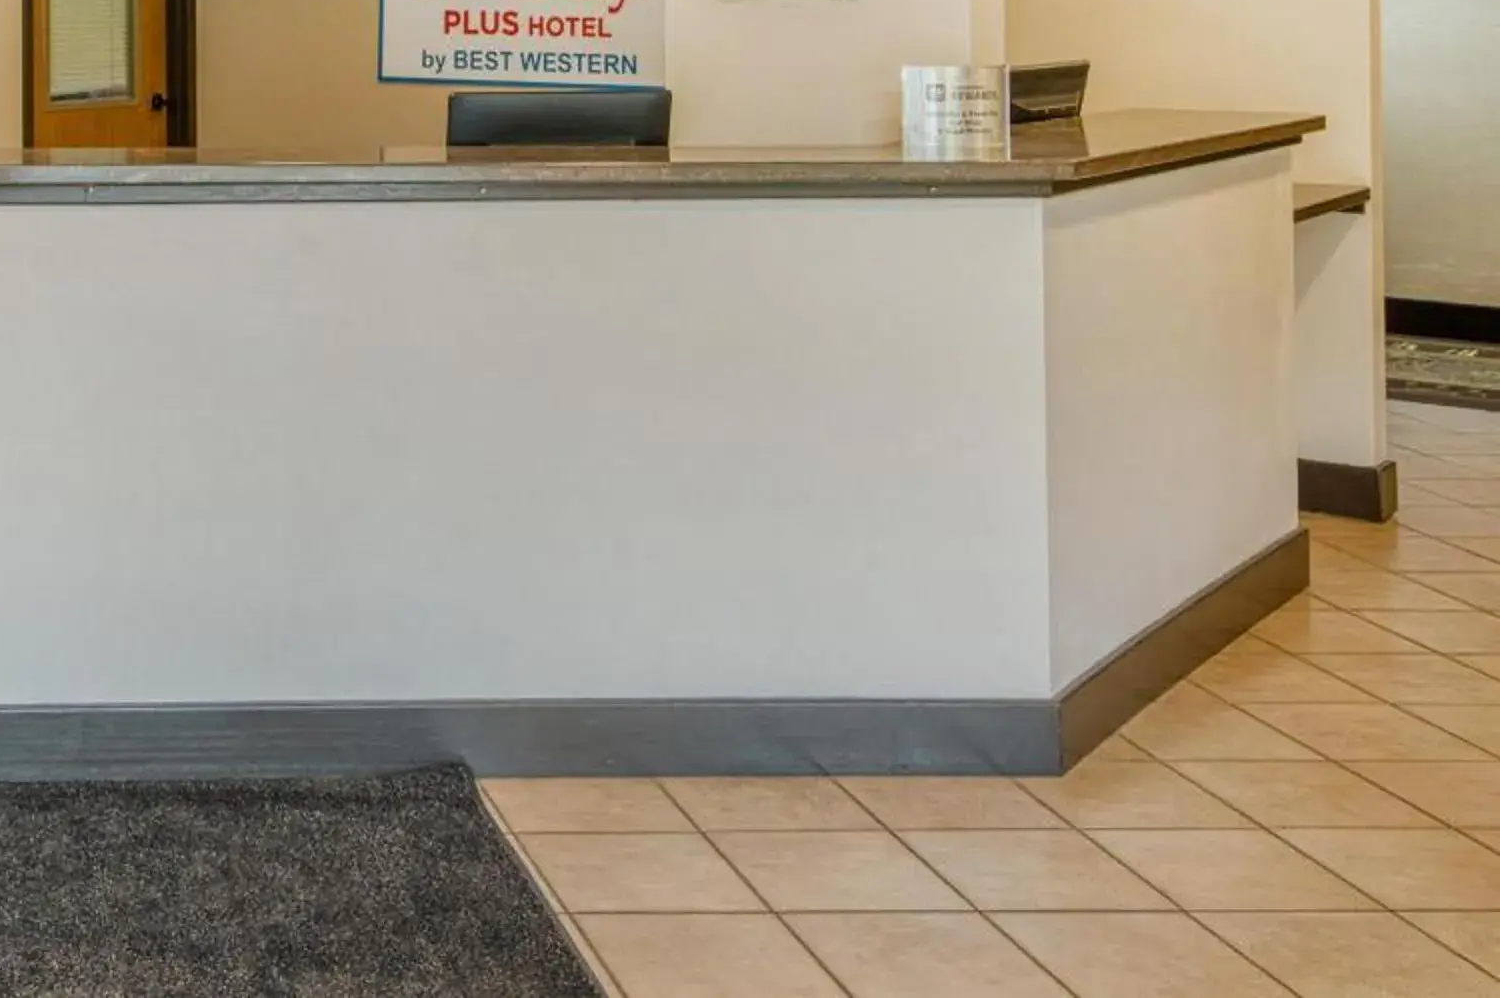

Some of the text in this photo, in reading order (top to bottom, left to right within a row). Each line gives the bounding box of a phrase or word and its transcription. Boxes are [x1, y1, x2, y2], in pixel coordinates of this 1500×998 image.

[444, 10, 613, 38] PLUS HOTEL
[421, 49, 638, 75] by BEST WESTERN
